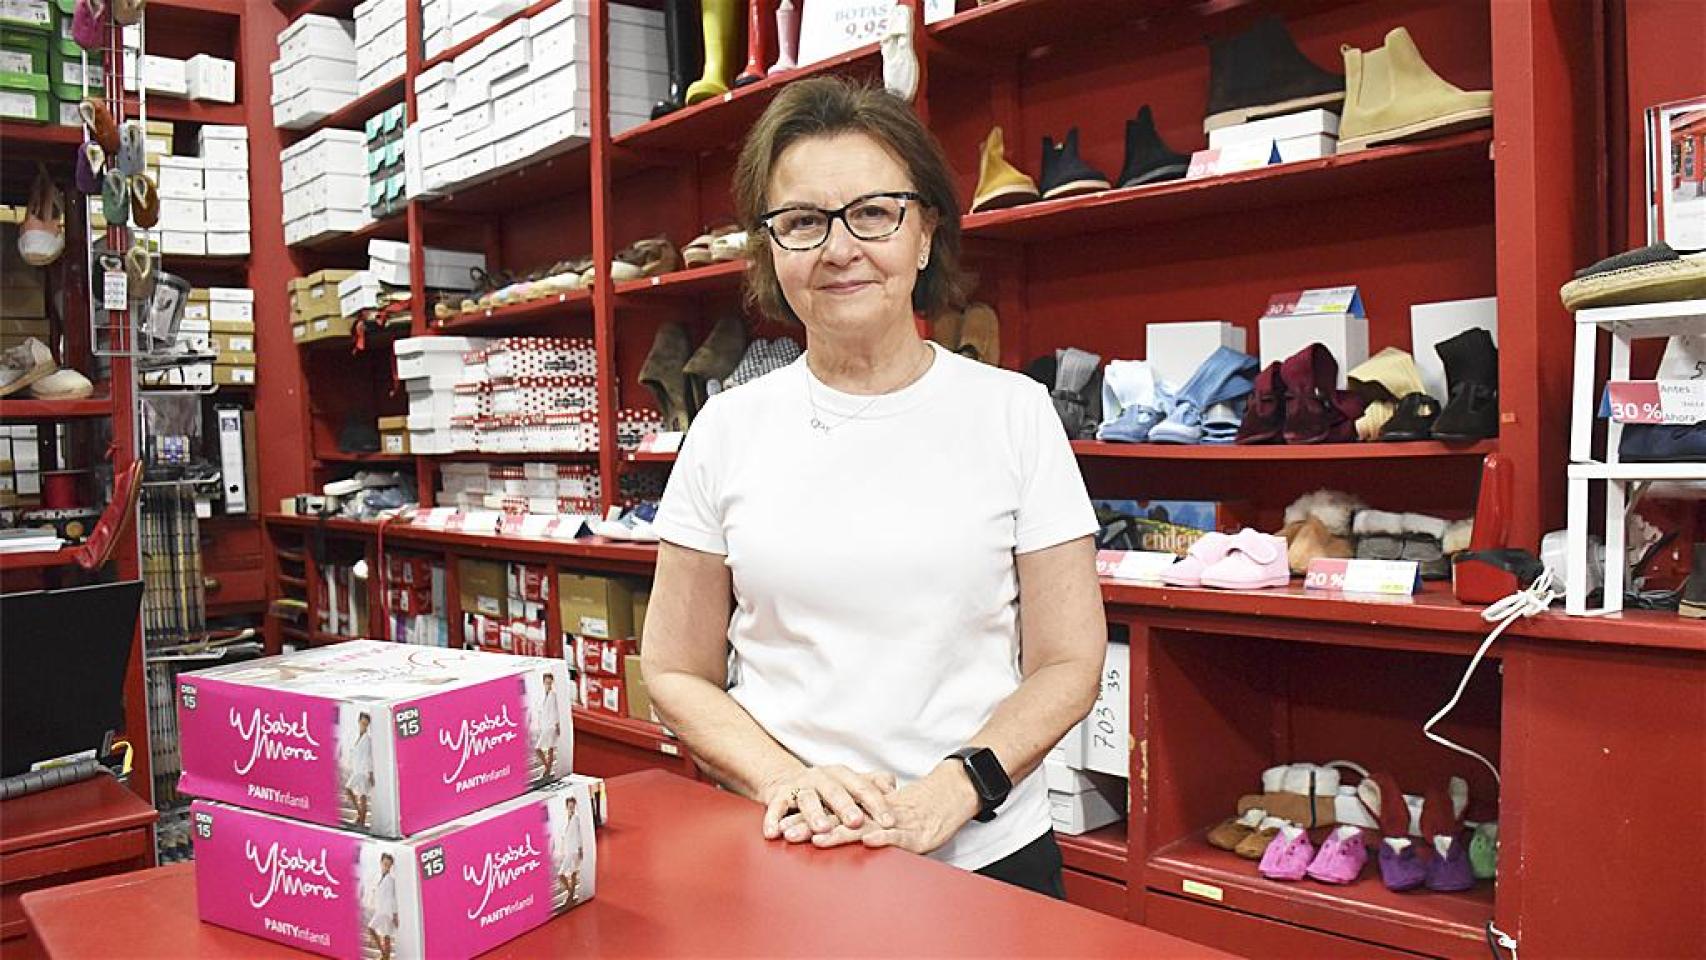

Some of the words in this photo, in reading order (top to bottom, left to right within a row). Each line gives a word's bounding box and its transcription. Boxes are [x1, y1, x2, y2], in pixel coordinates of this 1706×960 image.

[1612, 402, 1638, 420] 30
[1643, 402, 1662, 420] %
[1664, 413, 1697, 423] Ahora
[1107, 669, 1121, 692] 35
[183, 694, 197, 709] 15
[395, 707, 419, 723] DEN
[399, 719, 420, 737] 15
[1093, 706, 1116, 750] 703
[229, 706, 320, 776] Ysabel
[257, 734, 319, 761] Mora
[439, 704, 518, 784] Ysabel
[465, 732, 518, 761] Mora
[197, 823, 212, 838] 15
[420, 846, 443, 863] DEN
[245, 839, 341, 909] Ysabel
[423, 859, 445, 876] 15
[463, 832, 542, 920] Ysabel
[489, 858, 542, 892] Mora
[274, 868, 340, 900] Mora
